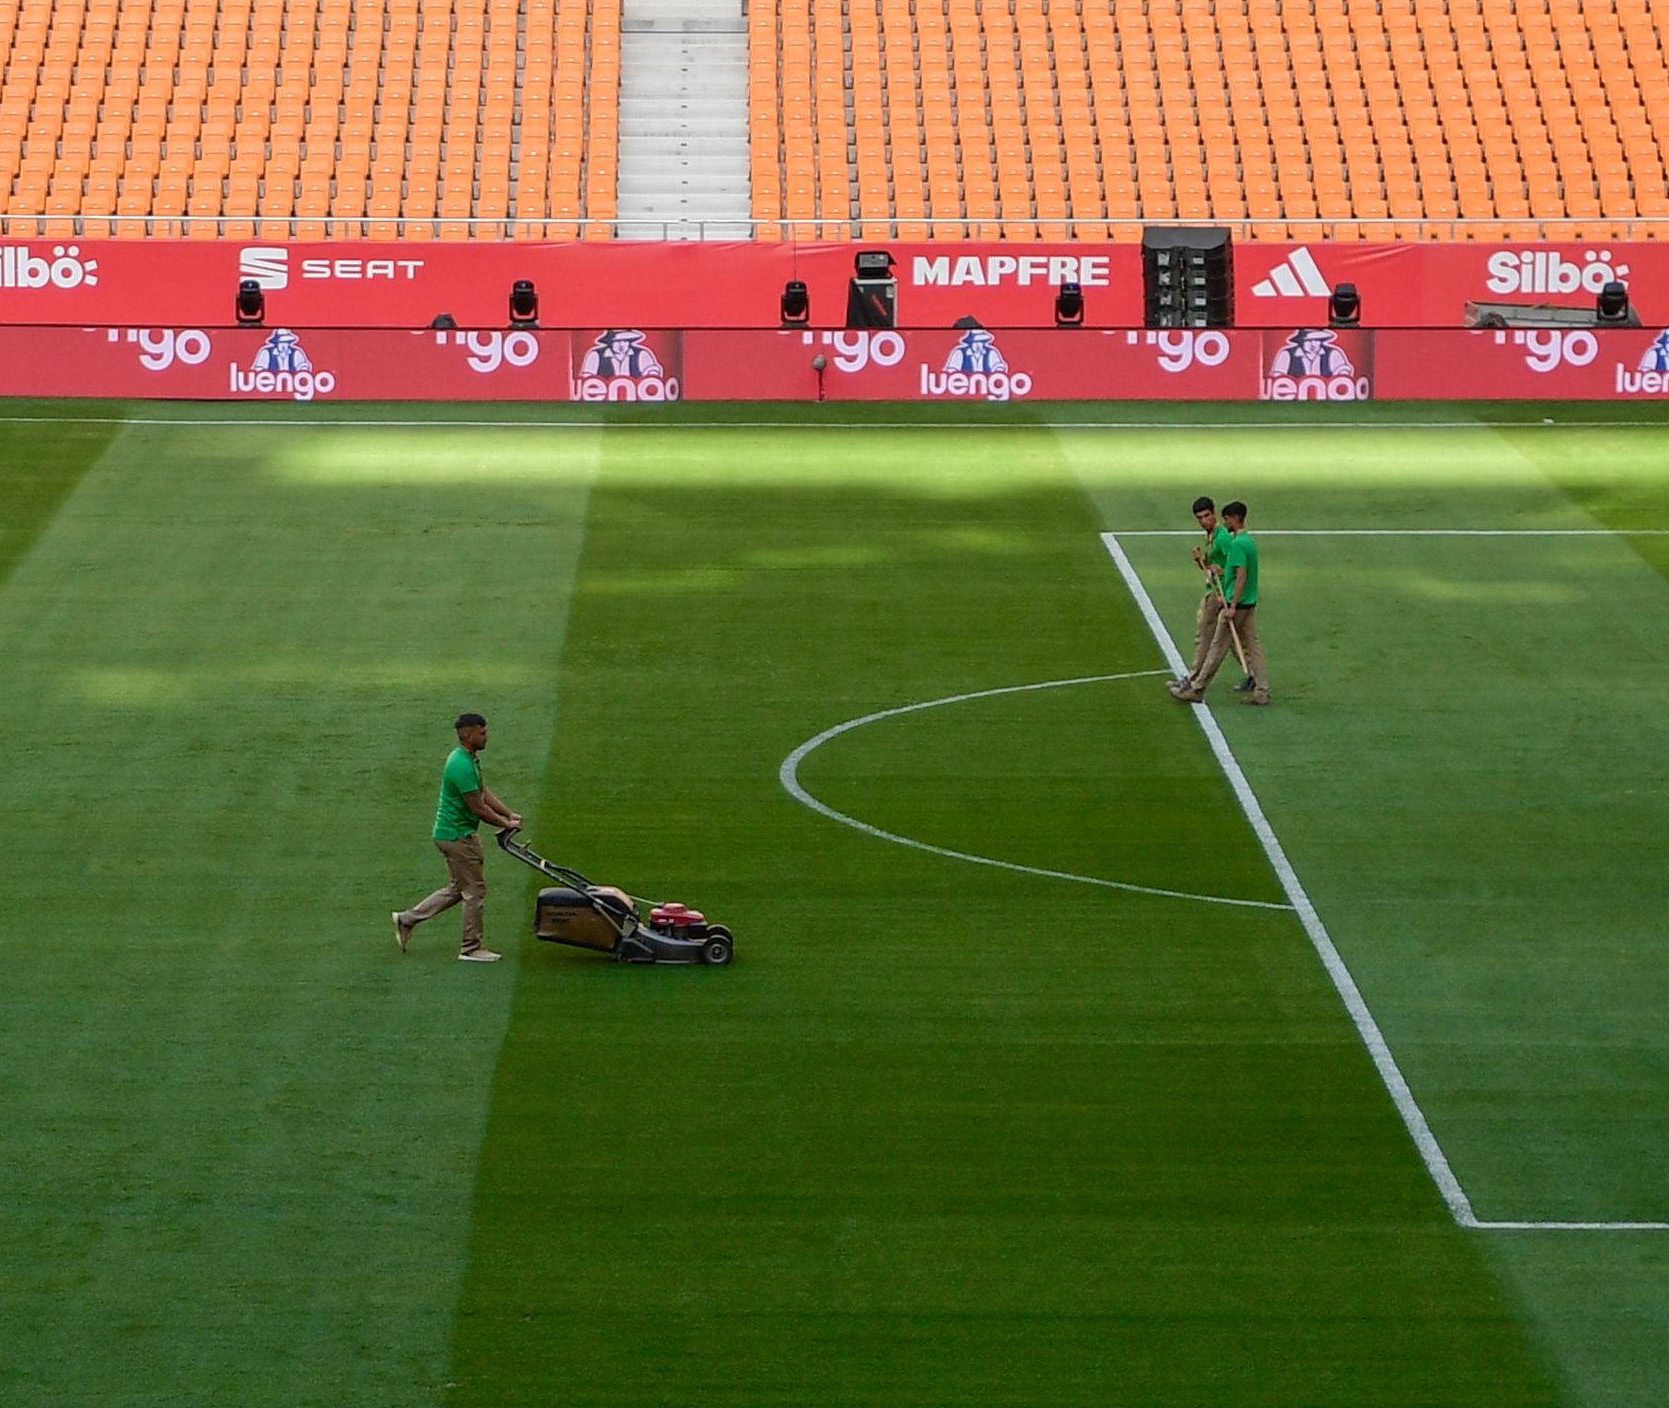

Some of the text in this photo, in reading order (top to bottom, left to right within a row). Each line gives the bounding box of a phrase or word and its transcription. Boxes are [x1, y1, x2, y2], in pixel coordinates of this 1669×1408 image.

[301, 259, 425, 279] SEAT
[912, 255, 1111, 286] MAPFRE
[229, 362, 335, 400] luengo
[920, 365, 1032, 400] luengo
